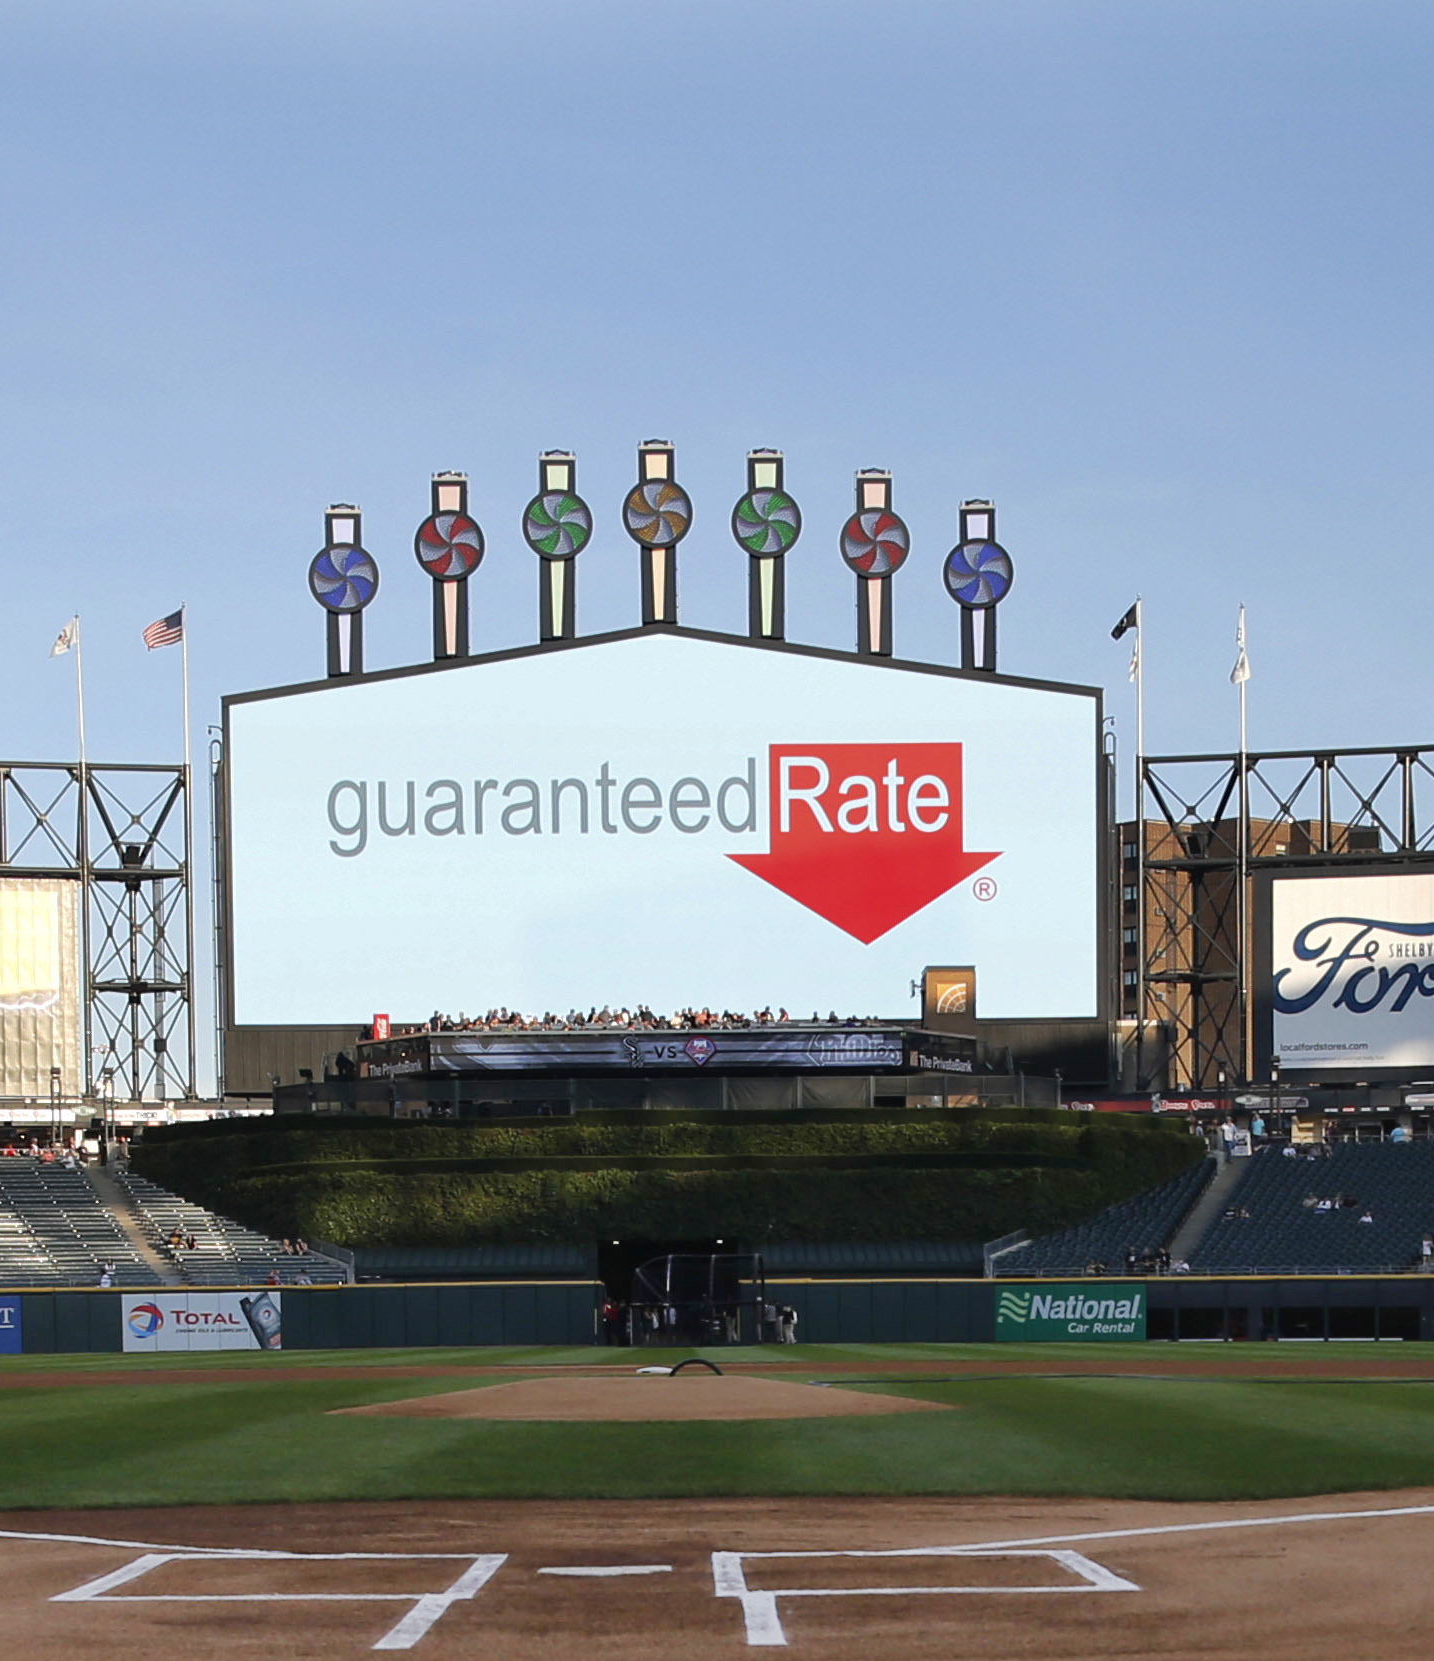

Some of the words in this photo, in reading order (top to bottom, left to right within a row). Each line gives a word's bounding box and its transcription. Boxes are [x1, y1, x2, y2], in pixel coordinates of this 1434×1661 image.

[326, 757, 758, 858] guaranteed
[779, 755, 951, 834] Rate
[1389, 943, 1433, 958] SHELBY
[654, 1046, 677, 1059] VS
[1279, 1042, 1369, 1052] localfordstores.com
[369, 1064, 381, 1076] The
[919, 1054, 932, 1068] The
[932, 1056, 973, 1073] PrivateBank
[1068, 1322, 1090, 1333] Car
[1093, 1322, 1135, 1333] Rental
